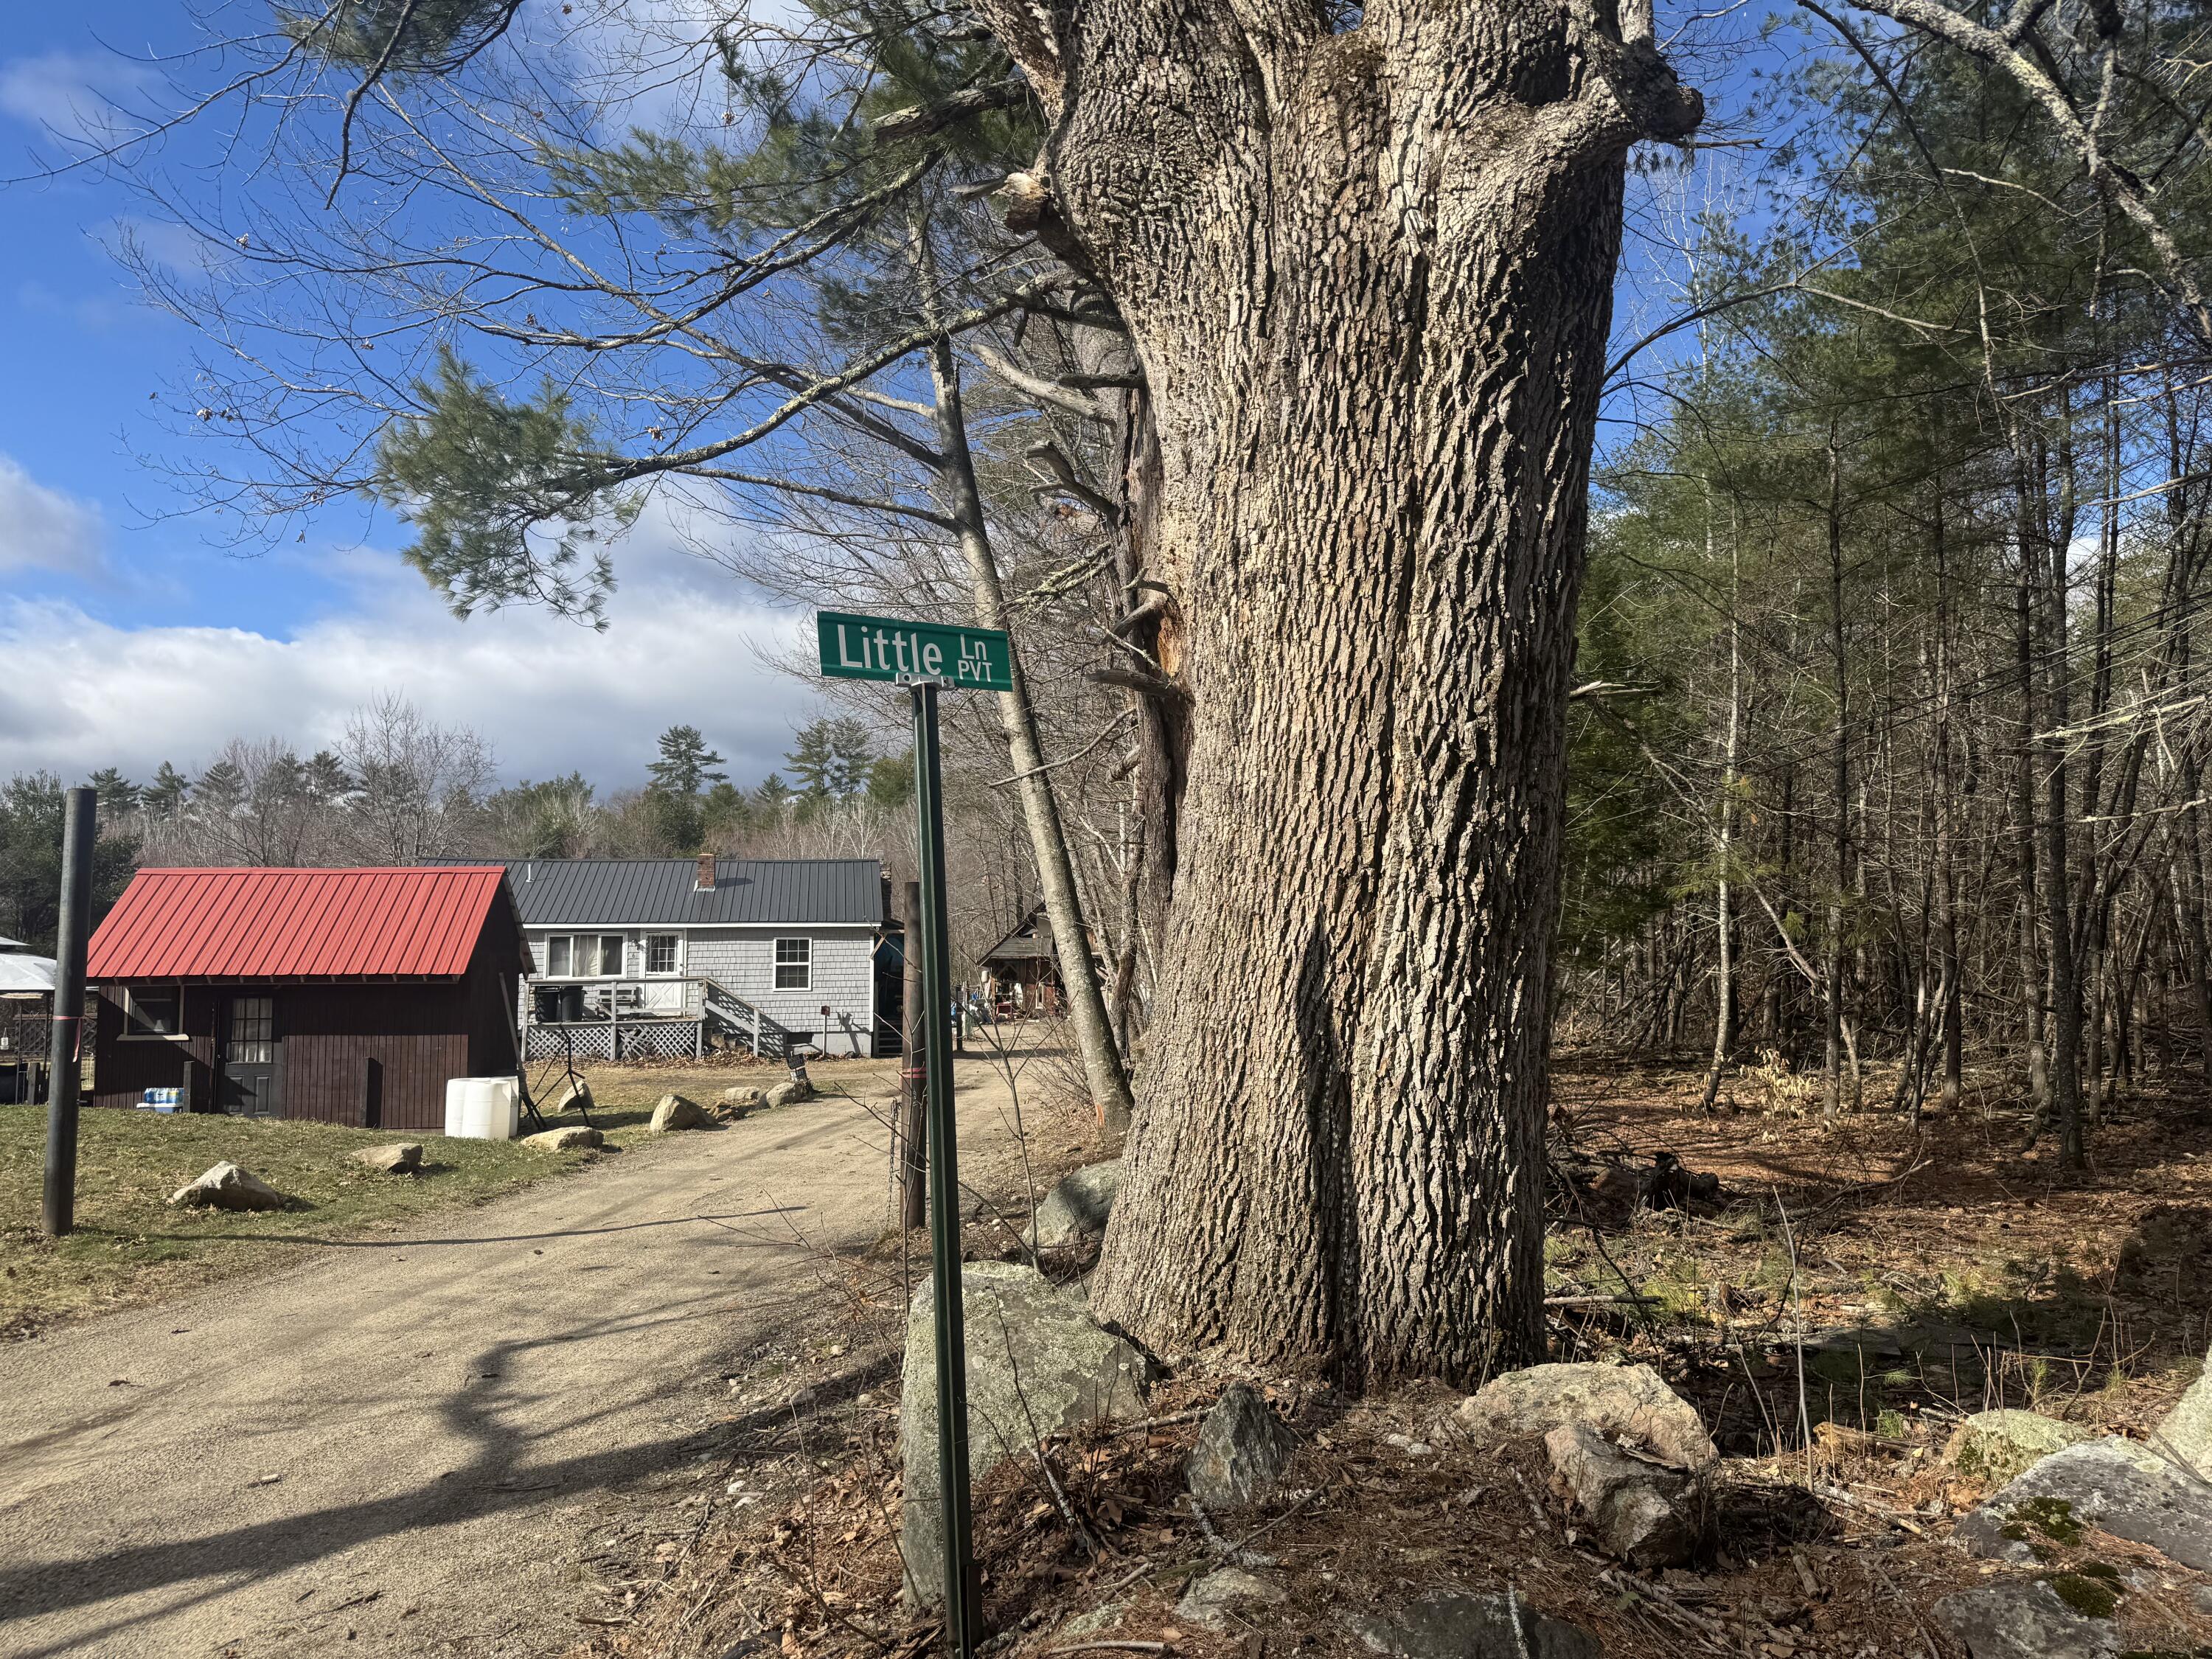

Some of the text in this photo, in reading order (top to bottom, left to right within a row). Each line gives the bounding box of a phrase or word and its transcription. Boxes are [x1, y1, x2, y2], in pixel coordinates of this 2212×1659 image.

[838, 624, 987, 675] Little Ln
[958, 659, 992, 682] PVT
